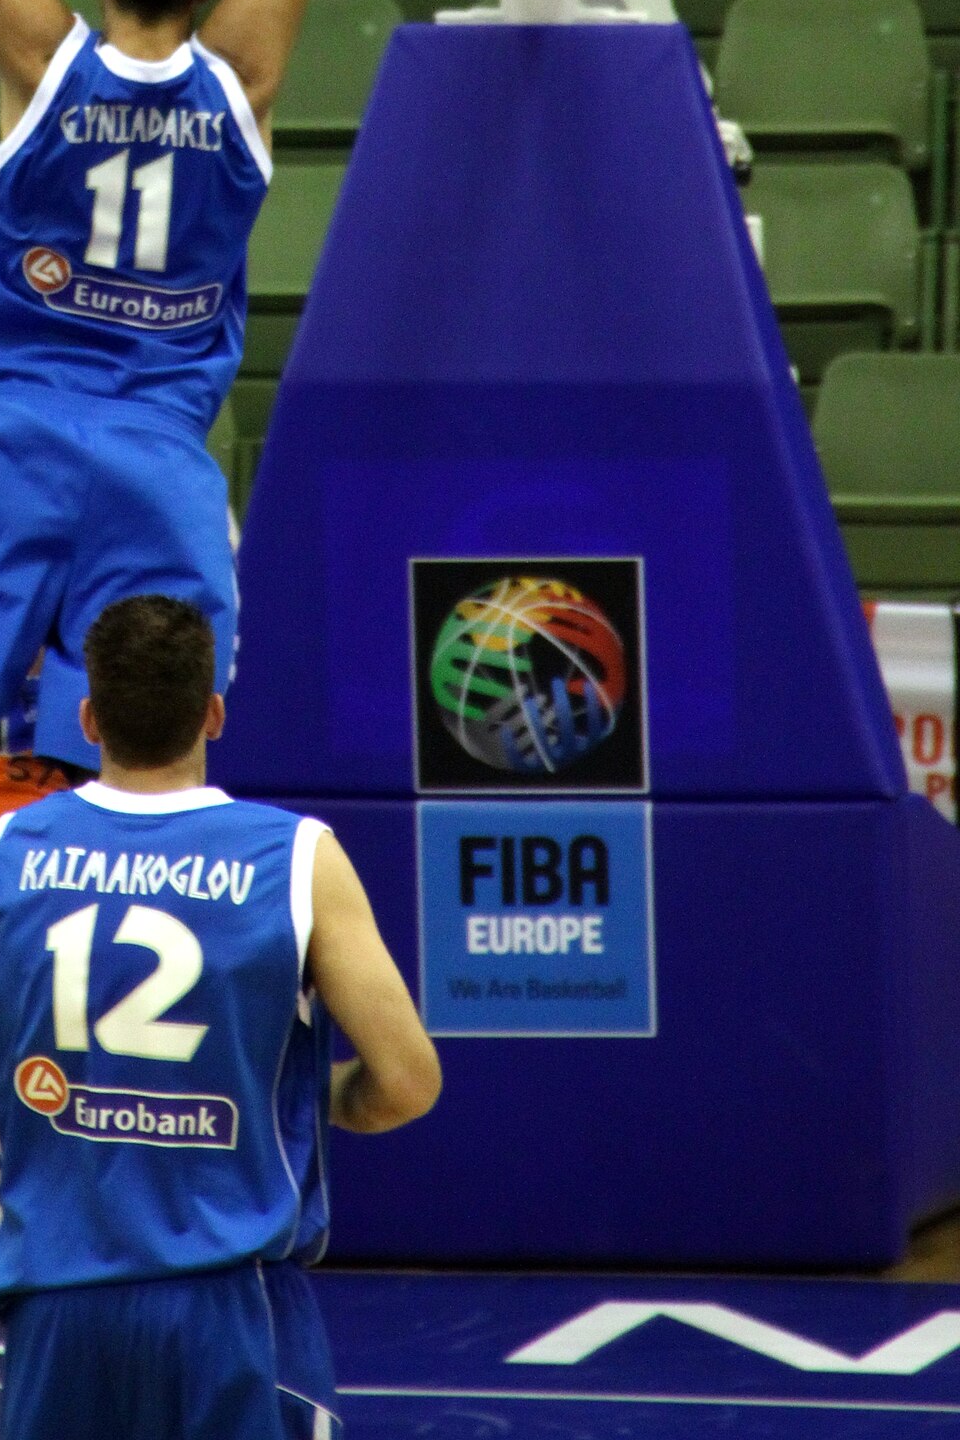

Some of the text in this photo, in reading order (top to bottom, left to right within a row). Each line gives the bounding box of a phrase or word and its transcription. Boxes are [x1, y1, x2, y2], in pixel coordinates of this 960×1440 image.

[83, 148, 174, 272] 11
[73, 280, 209, 321] Eurobank
[18, 847, 256, 906] KAIMAKOGLOU
[458, 835, 611, 907] FIBA
[466, 914, 605, 955] EUROPE
[45, 902, 210, 1064] 12
[74, 1097, 218, 1137] Eurobank
